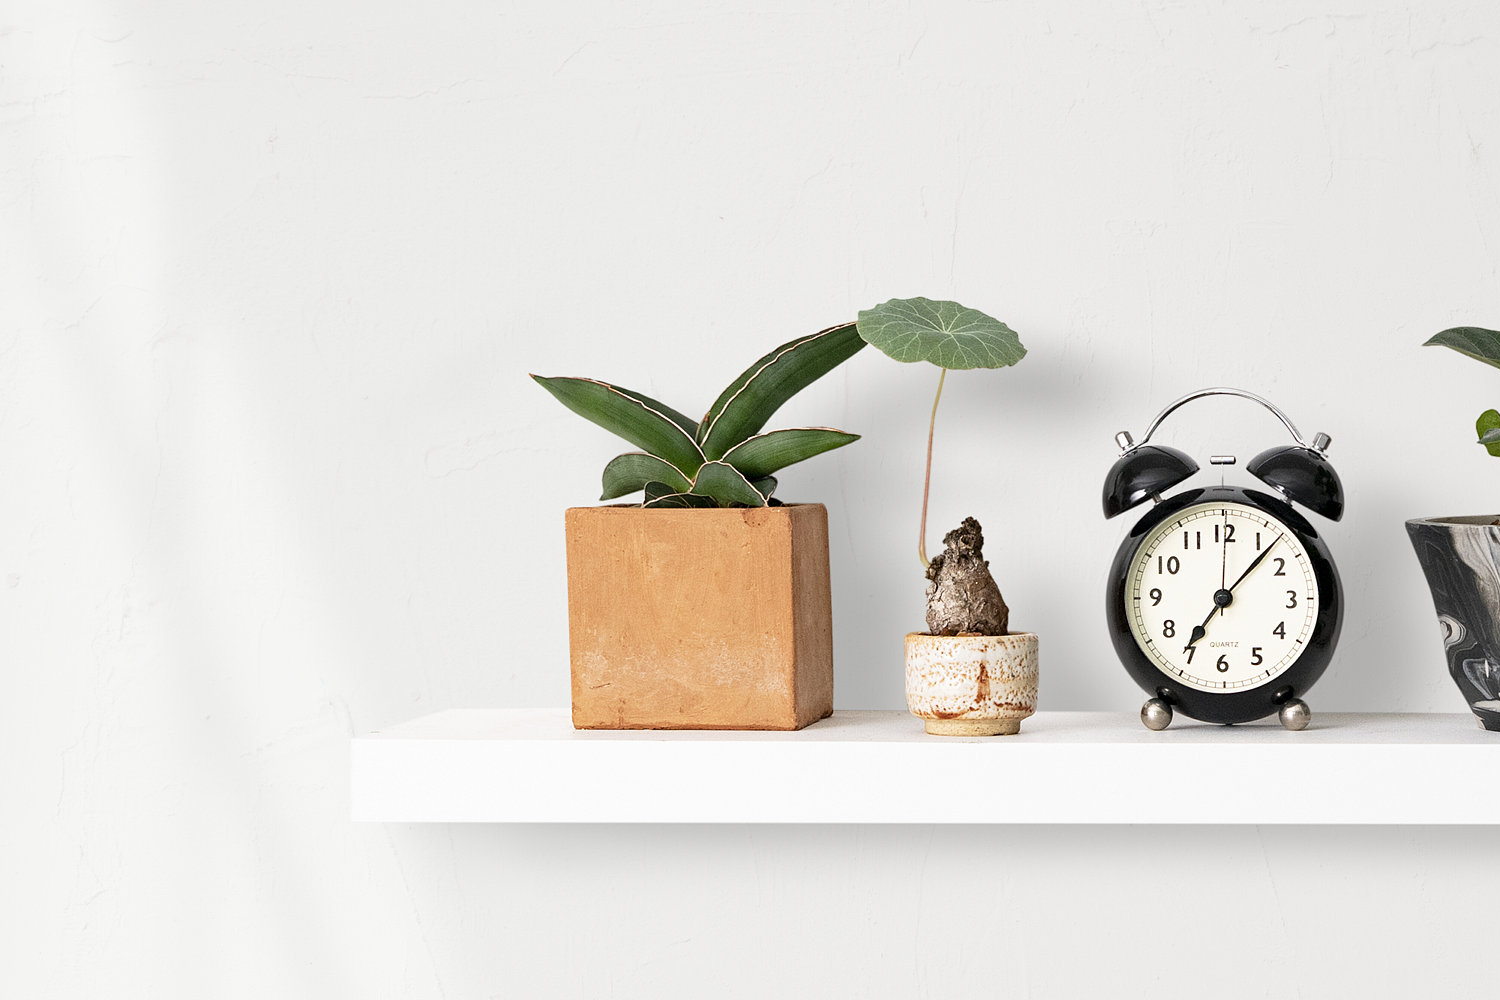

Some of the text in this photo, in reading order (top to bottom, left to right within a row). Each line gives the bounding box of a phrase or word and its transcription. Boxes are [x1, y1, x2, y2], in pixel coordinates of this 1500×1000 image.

[1183, 531, 1201, 549] 11
[1214, 524, 1236, 543] 12
[1255, 532, 1261, 550] 1
[1158, 556, 1180, 575] 10
[1274, 558, 1286, 576] 2
[1149, 588, 1162, 606] 9
[1286, 590, 1297, 609] 3
[1163, 620, 1175, 638] 8
[1272, 621, 1286, 639] 4
[1184, 646, 1196, 664] 7
[1216, 654, 1229, 672] 6
[1251, 647, 1263, 665] 5
